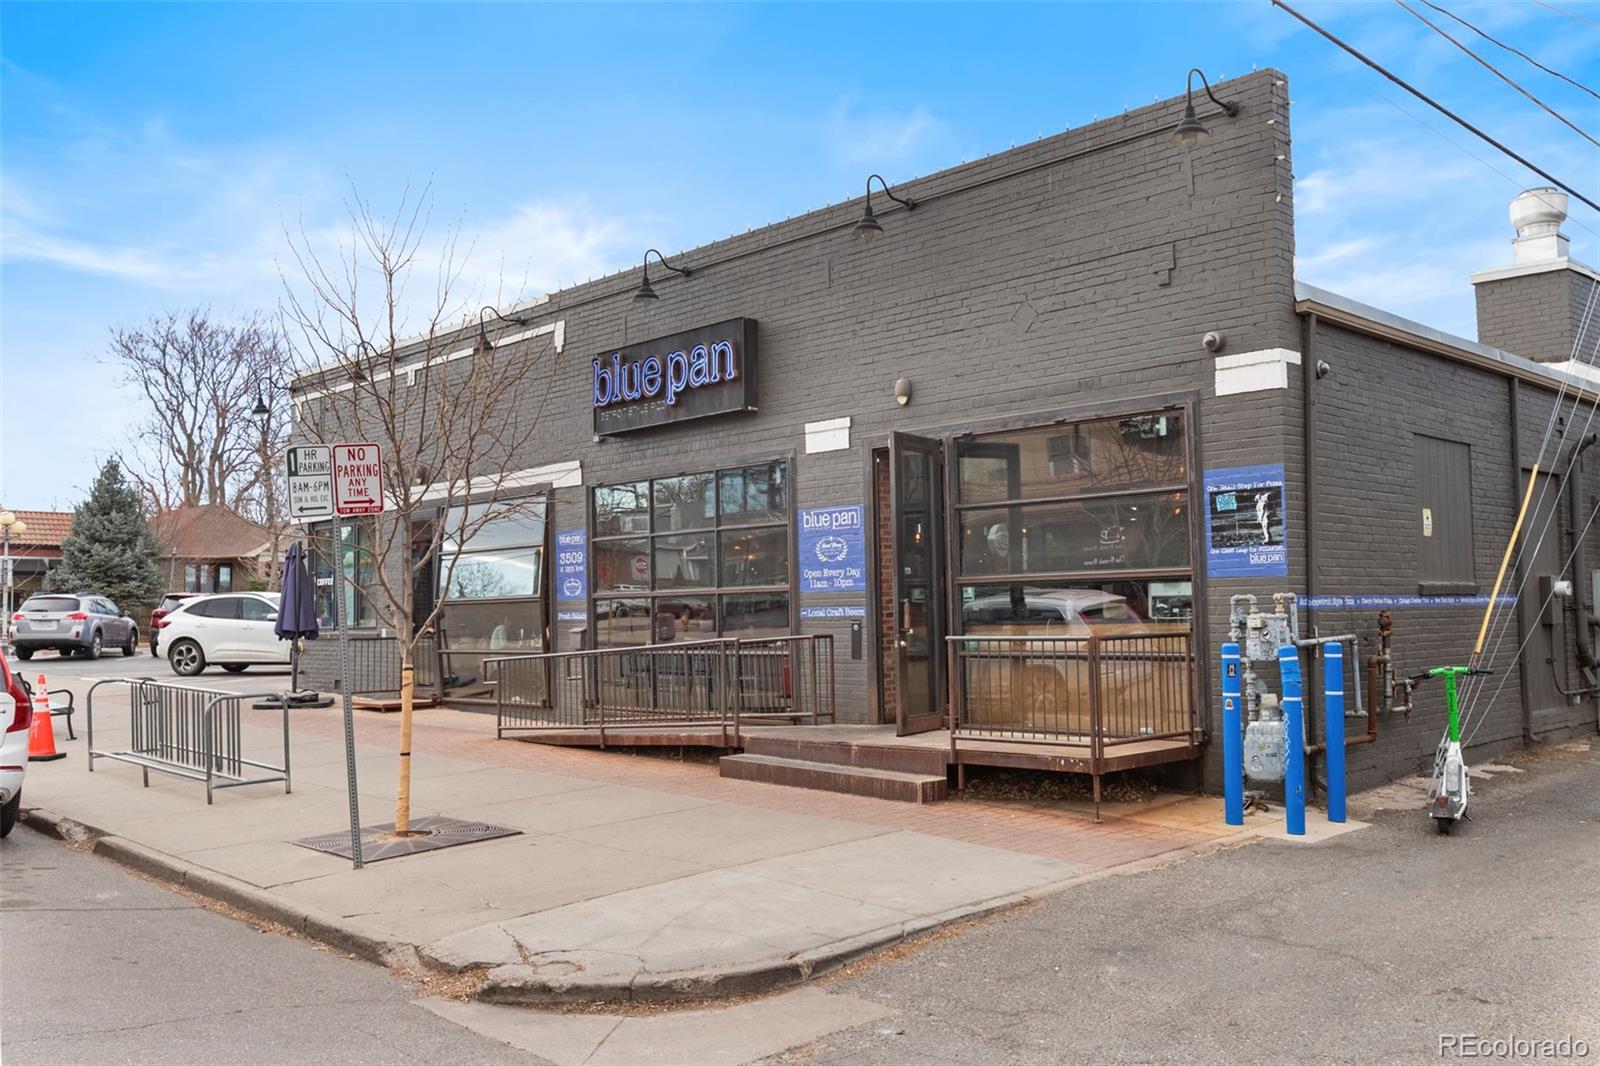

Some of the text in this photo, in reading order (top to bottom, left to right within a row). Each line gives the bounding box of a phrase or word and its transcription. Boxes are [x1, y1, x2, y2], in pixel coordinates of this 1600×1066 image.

[592, 339, 735, 407] blue pan
[304, 449, 317, 460] HR
[347, 448, 366, 461] NO
[299, 461, 330, 474] PARKING
[337, 463, 379, 478] PARKING
[292, 480, 330, 493] 8AM-6PM
[348, 477, 367, 487] ANY
[348, 488, 369, 497] TIME
[803, 510, 857, 529] blue pan
[559, 552, 583, 565] 3509
[1267, 552, 1284, 562] pan
[803, 567, 860, 579] Open Every Day
[809, 580, 828, 588] 11am
[834, 578, 854, 588] 10pm
[808, 608, 826, 617] Local
[827, 607, 844, 617] Craft
